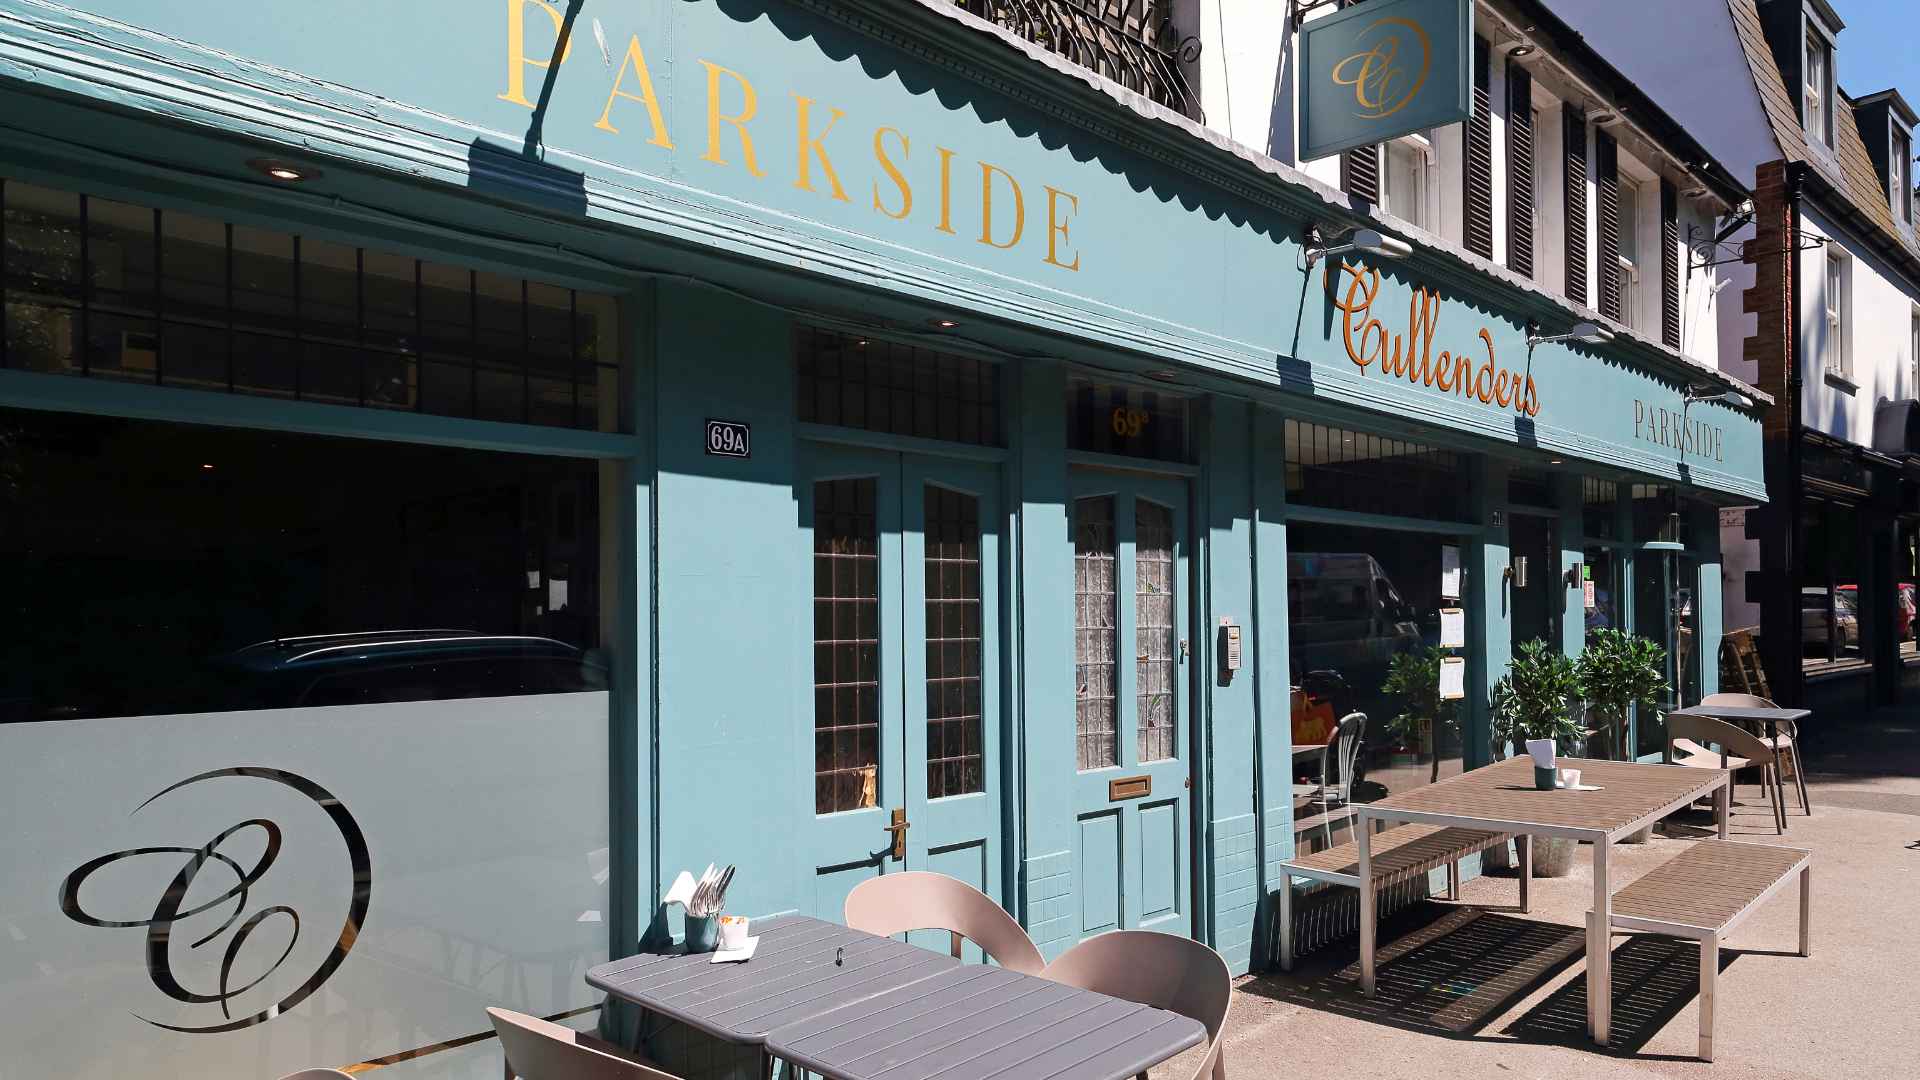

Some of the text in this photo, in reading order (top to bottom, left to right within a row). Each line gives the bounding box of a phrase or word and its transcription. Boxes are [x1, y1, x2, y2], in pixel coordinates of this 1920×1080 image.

[496, 0, 1079, 272] PARKSIDE
[1323, 248, 1540, 416] Cullenders
[711, 425, 745, 452] 69A
[1634, 399, 1723, 464] PARKSIDE
